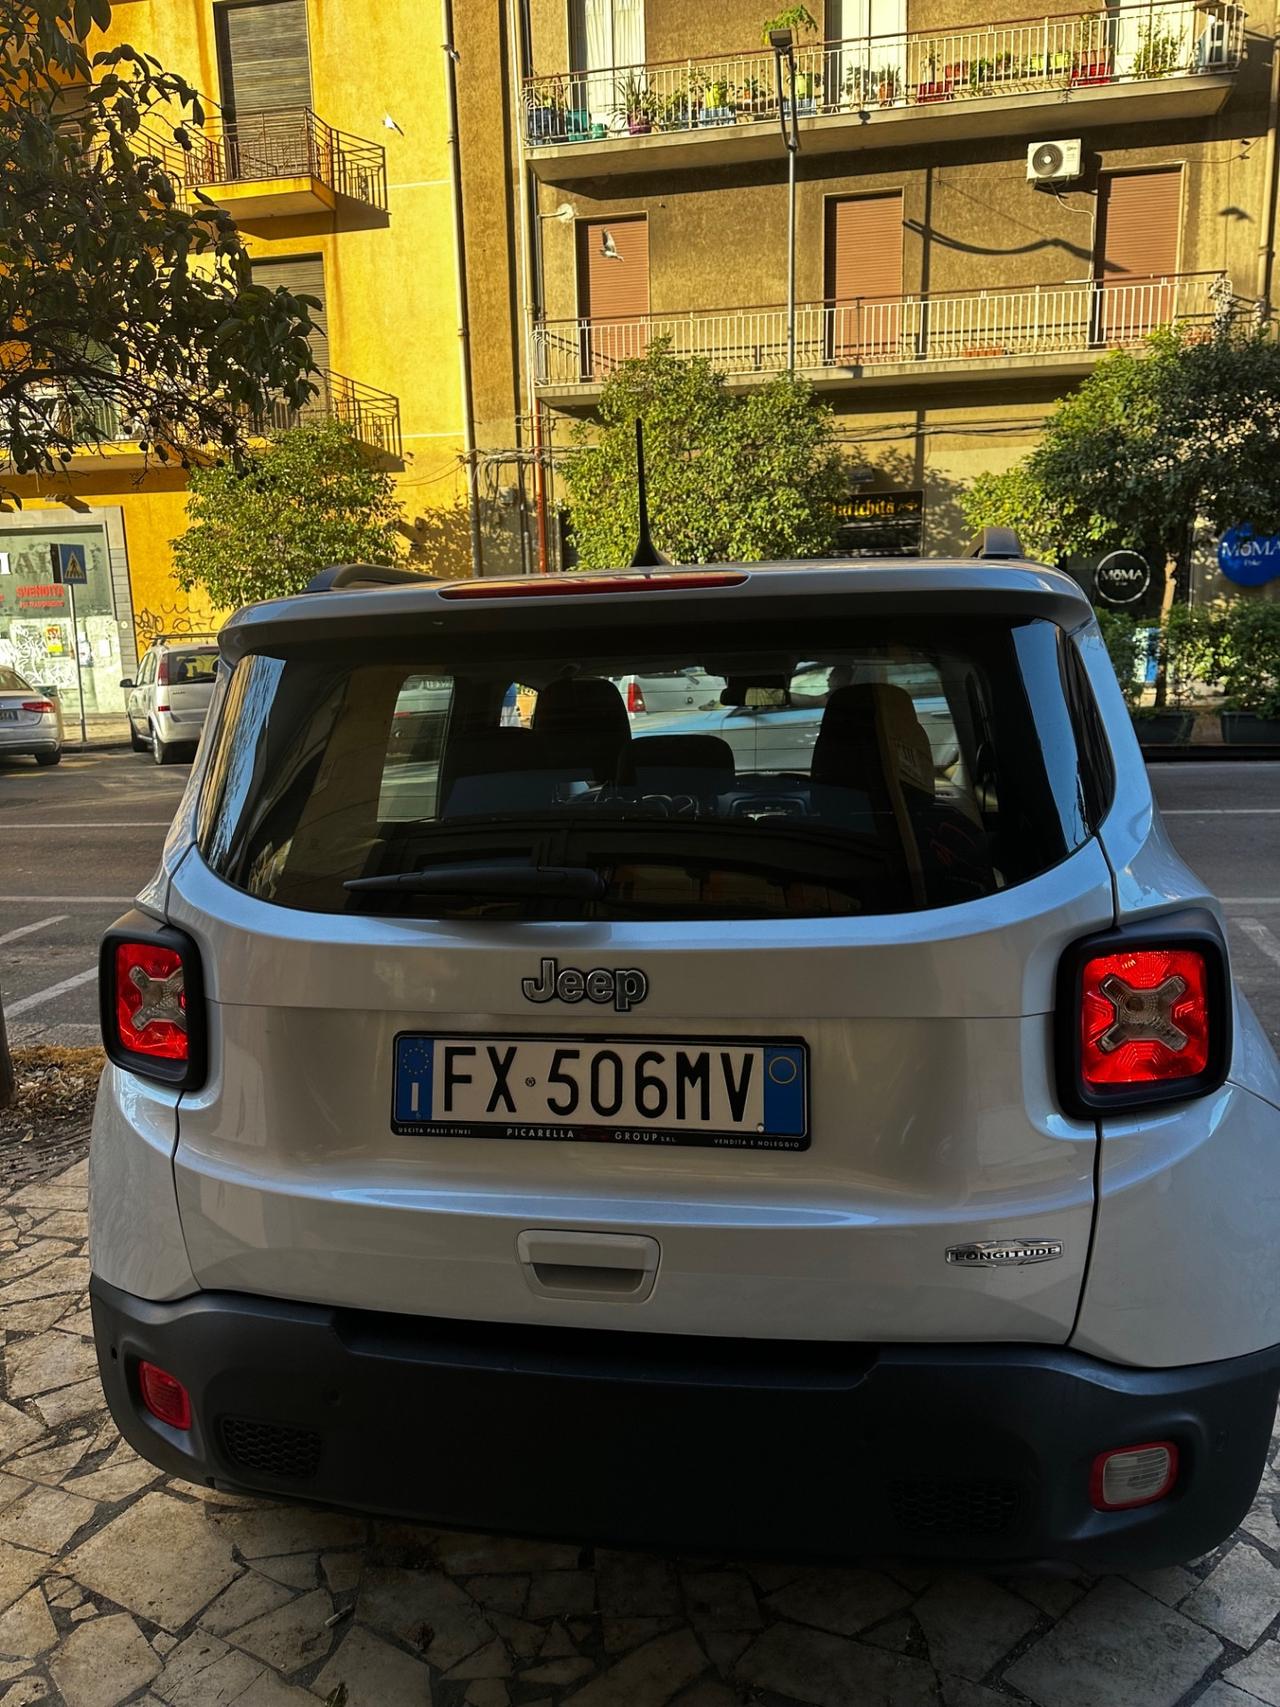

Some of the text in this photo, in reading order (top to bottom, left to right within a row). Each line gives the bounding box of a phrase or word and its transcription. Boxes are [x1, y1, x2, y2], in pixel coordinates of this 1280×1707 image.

[522, 957, 648, 1012] Jeep
[443, 1046, 755, 1122] FX 506MV
[505, 1128, 576, 1138] PICARELLA
[614, 1131, 659, 1142] GROUP
[954, 1246, 1058, 1262] LONGITUDE
